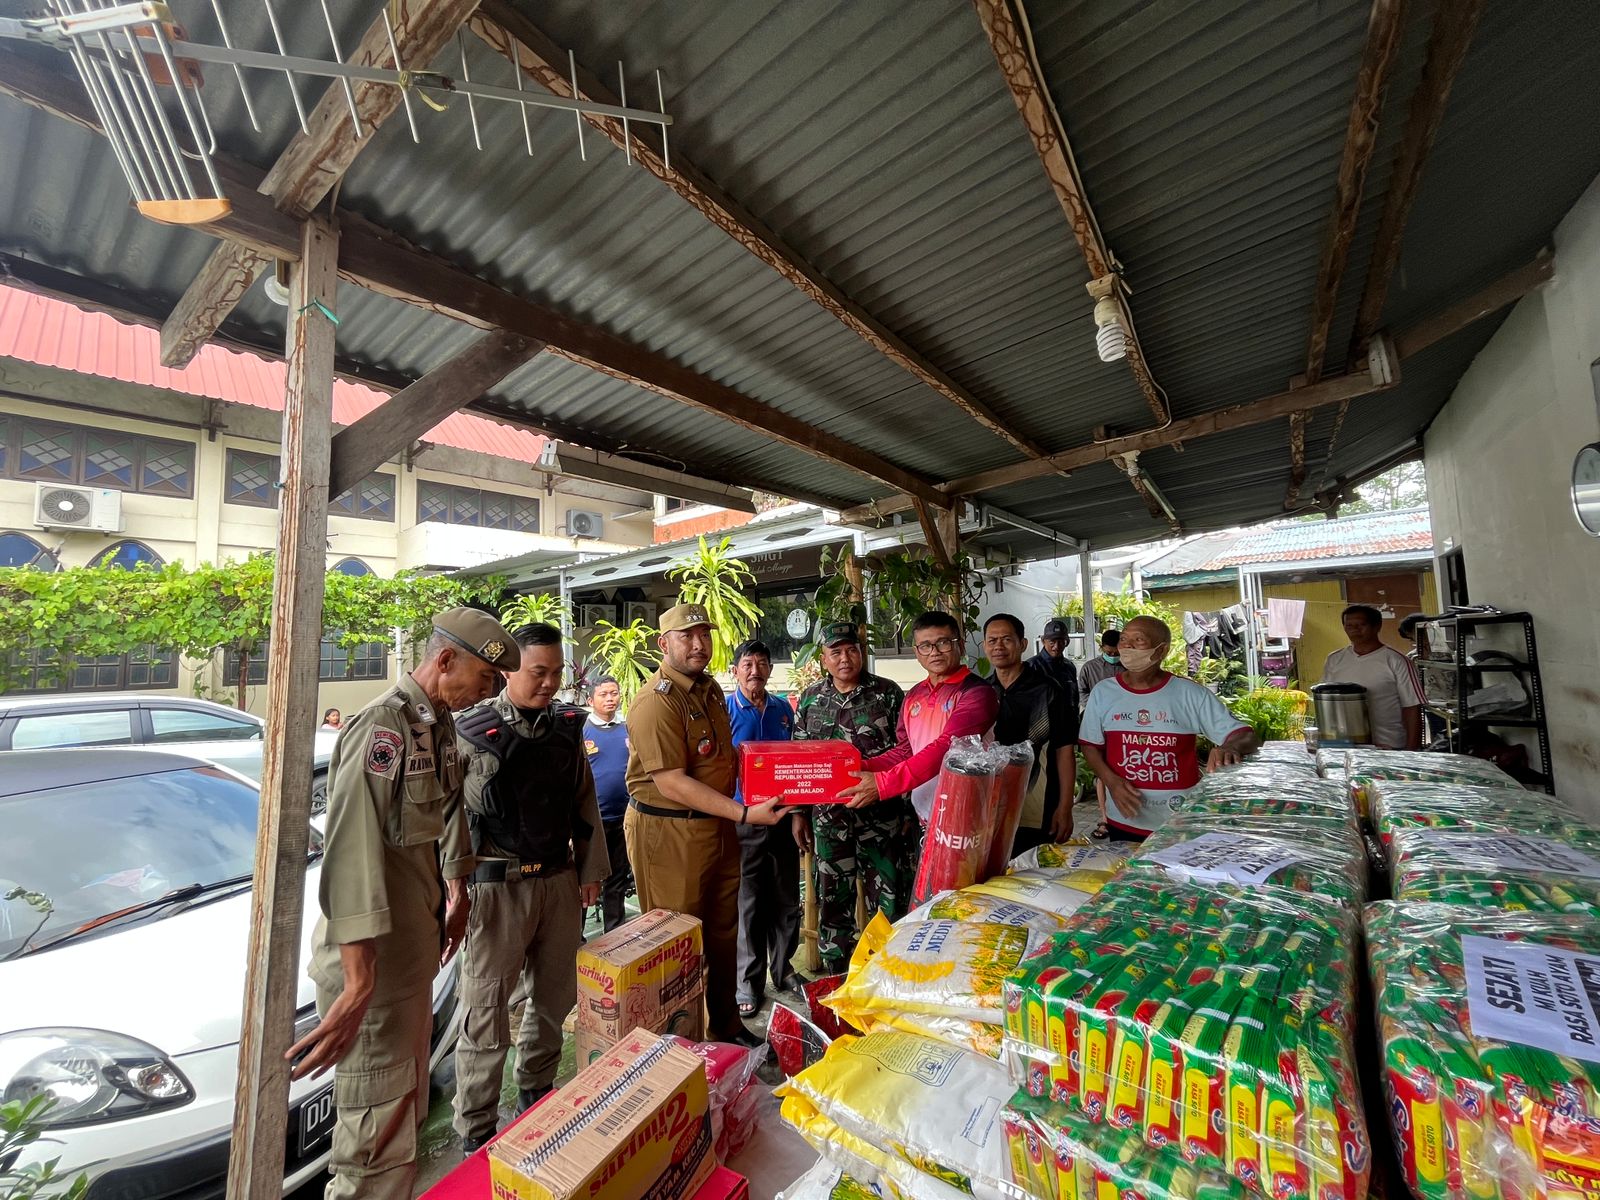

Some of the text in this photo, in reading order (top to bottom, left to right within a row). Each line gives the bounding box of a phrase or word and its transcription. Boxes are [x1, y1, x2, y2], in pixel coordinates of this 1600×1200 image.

[1118, 745, 1178, 767] Jalan
[1122, 734, 1178, 746] MAKASSAR
[1125, 764, 1179, 783] Sehat
[521, 863, 542, 873] POL PP
[906, 921, 934, 952] BERAS
[637, 938, 681, 976] sarimi
[680, 936, 693, 963] 2
[1545, 953, 1573, 983] AYAM
[577, 964, 606, 984] sarimi
[603, 977, 614, 995] 2
[1482, 955, 1526, 1014] SEJATI
[1526, 969, 1558, 1012] MI KUAH
[1554, 983, 1583, 1010] SOTO
[1562, 1010, 1596, 1046] RASA
[306, 1094, 332, 1132] DD
[590, 1105, 667, 1198] sarimi
[666, 1091, 690, 1142] 2
[682, 1129, 706, 1171] KECAP
[1426, 1125, 1437, 1167] RASA SOTO
